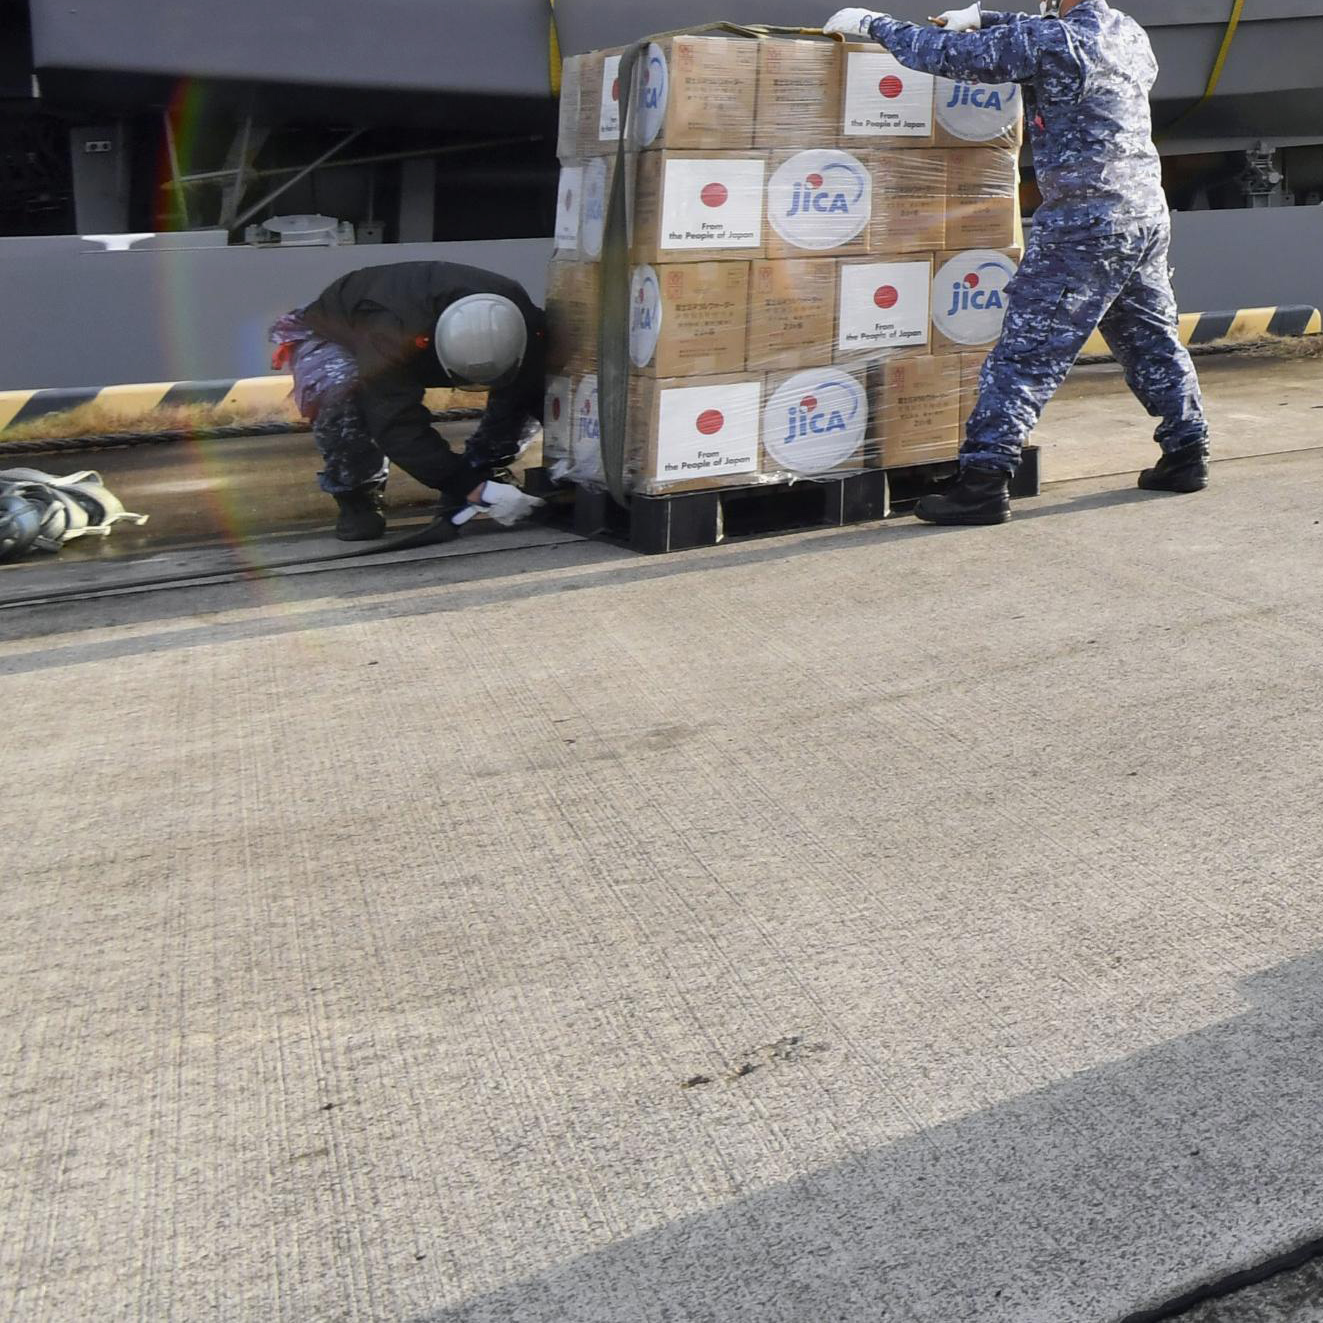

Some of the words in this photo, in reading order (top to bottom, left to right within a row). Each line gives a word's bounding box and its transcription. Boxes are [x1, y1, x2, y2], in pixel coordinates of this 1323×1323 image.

[879, 112, 900, 120] From
[850, 119, 864, 127] the
[865, 119, 891, 129] People
[893, 118, 902, 128] of
[903, 120, 926, 129] Japan
[701, 222, 723, 230] From
[669, 232, 682, 240] the
[685, 231, 714, 242] People
[717, 230, 727, 239] of
[727, 231, 754, 241] Japan
[846, 333, 859, 341] the
[860, 332, 887, 341] People
[888, 330, 898, 338] of
[898, 330, 922, 339] Japan
[697, 450, 720, 460] From
[664, 463, 679, 472] the
[681, 460, 711, 472] People
[713, 458, 722, 467] of
[724, 456, 751, 467] Japan
